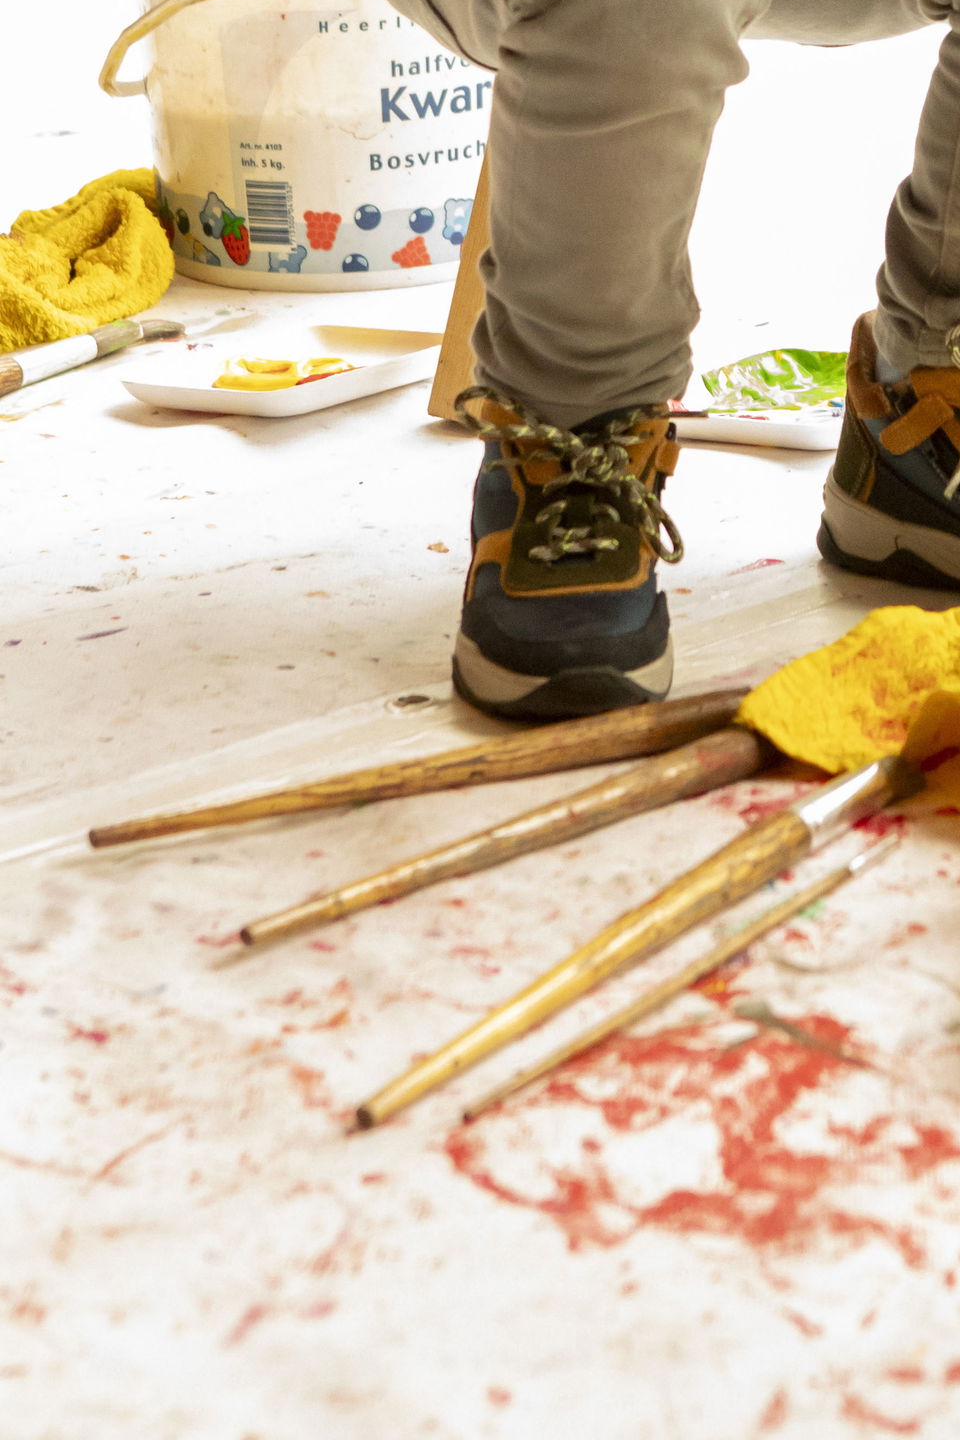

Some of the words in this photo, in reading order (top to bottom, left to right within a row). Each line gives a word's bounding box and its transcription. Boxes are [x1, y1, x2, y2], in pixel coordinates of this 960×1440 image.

[380, 80, 492, 123] Kwar
[241, 157, 259, 167] Inh.
[261, 159, 267, 168] 5
[270, 159, 286, 171] kg.
